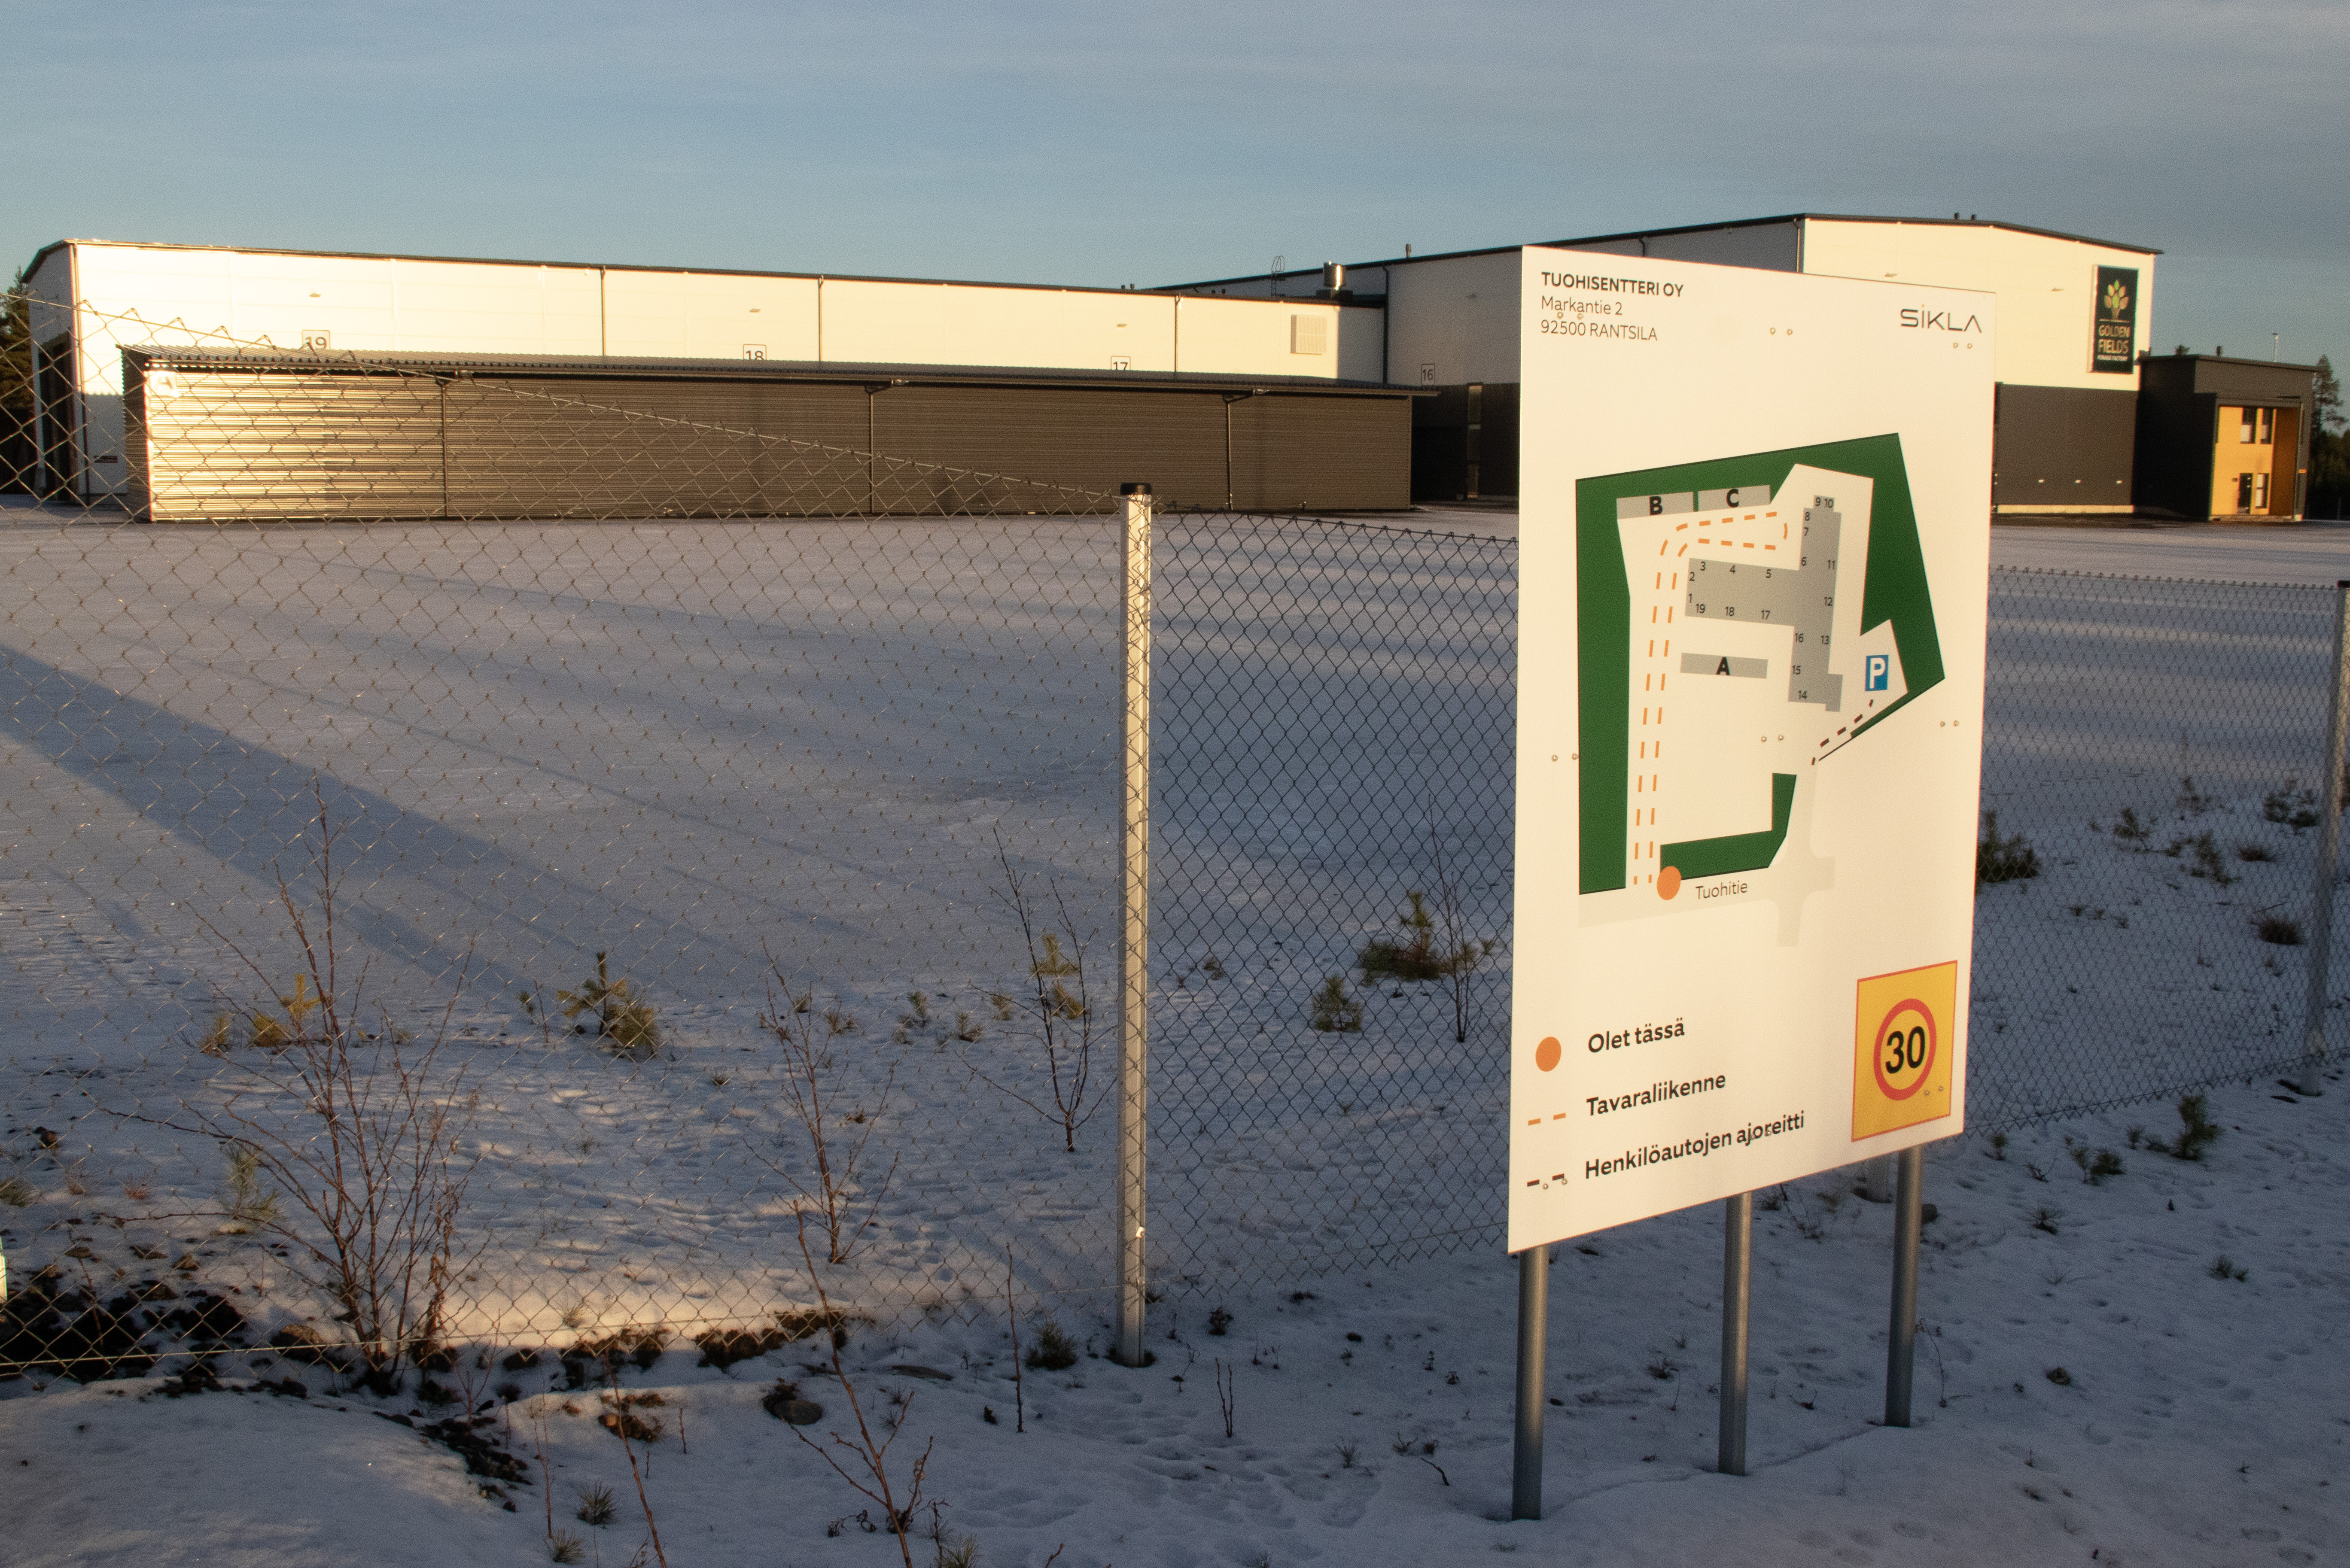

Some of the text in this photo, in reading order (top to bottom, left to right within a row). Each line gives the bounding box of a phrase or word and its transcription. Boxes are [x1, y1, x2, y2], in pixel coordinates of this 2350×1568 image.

[1541, 271, 1684, 298] TUOHISENTTERI OY
[1541, 295, 1622, 316] Markantie 2
[1541, 319, 1658, 341] 92500 RANTSILA
[305, 336, 327, 349] 19
[2098, 338, 2129, 354] FIELDS
[1422, 368, 1434, 381] 16
[1726, 488, 1740, 508] C
[1815, 498, 1821, 506] 9
[1824, 499, 1833, 508] 10
[1649, 495, 1663, 516] B
[1805, 512, 1810, 521] 8
[1804, 527, 1809, 536] 7
[1699, 561, 1706, 571] 3
[1801, 557, 1806, 566] 6
[1827, 560, 1836, 570] 11
[1729, 565, 1736, 574] 4
[1766, 569, 1772, 578] 5
[1689, 571, 1695, 582] 2
[1688, 593, 1692, 603] 1
[1824, 597, 1833, 606] 12
[1695, 603, 1705, 614] 19
[1725, 606, 1735, 617] 18
[1761, 610, 1770, 620] 17
[1794, 633, 1804, 643] 16
[1820, 635, 1829, 645] 13
[1716, 656, 1730, 676] A
[1792, 665, 1801, 675] 15
[1869, 657, 1886, 689] P
[1798, 690, 1807, 700] 14
[1695, 880, 1747, 899] Tuohitie
[1588, 1017, 1684, 1053] Olet tässä
[1885, 1026, 1926, 1074] 30
[1586, 1075, 1726, 1116] Tavaraliikenne
[1585, 1110, 1805, 1179] Henkilöautojen ajoreitti
